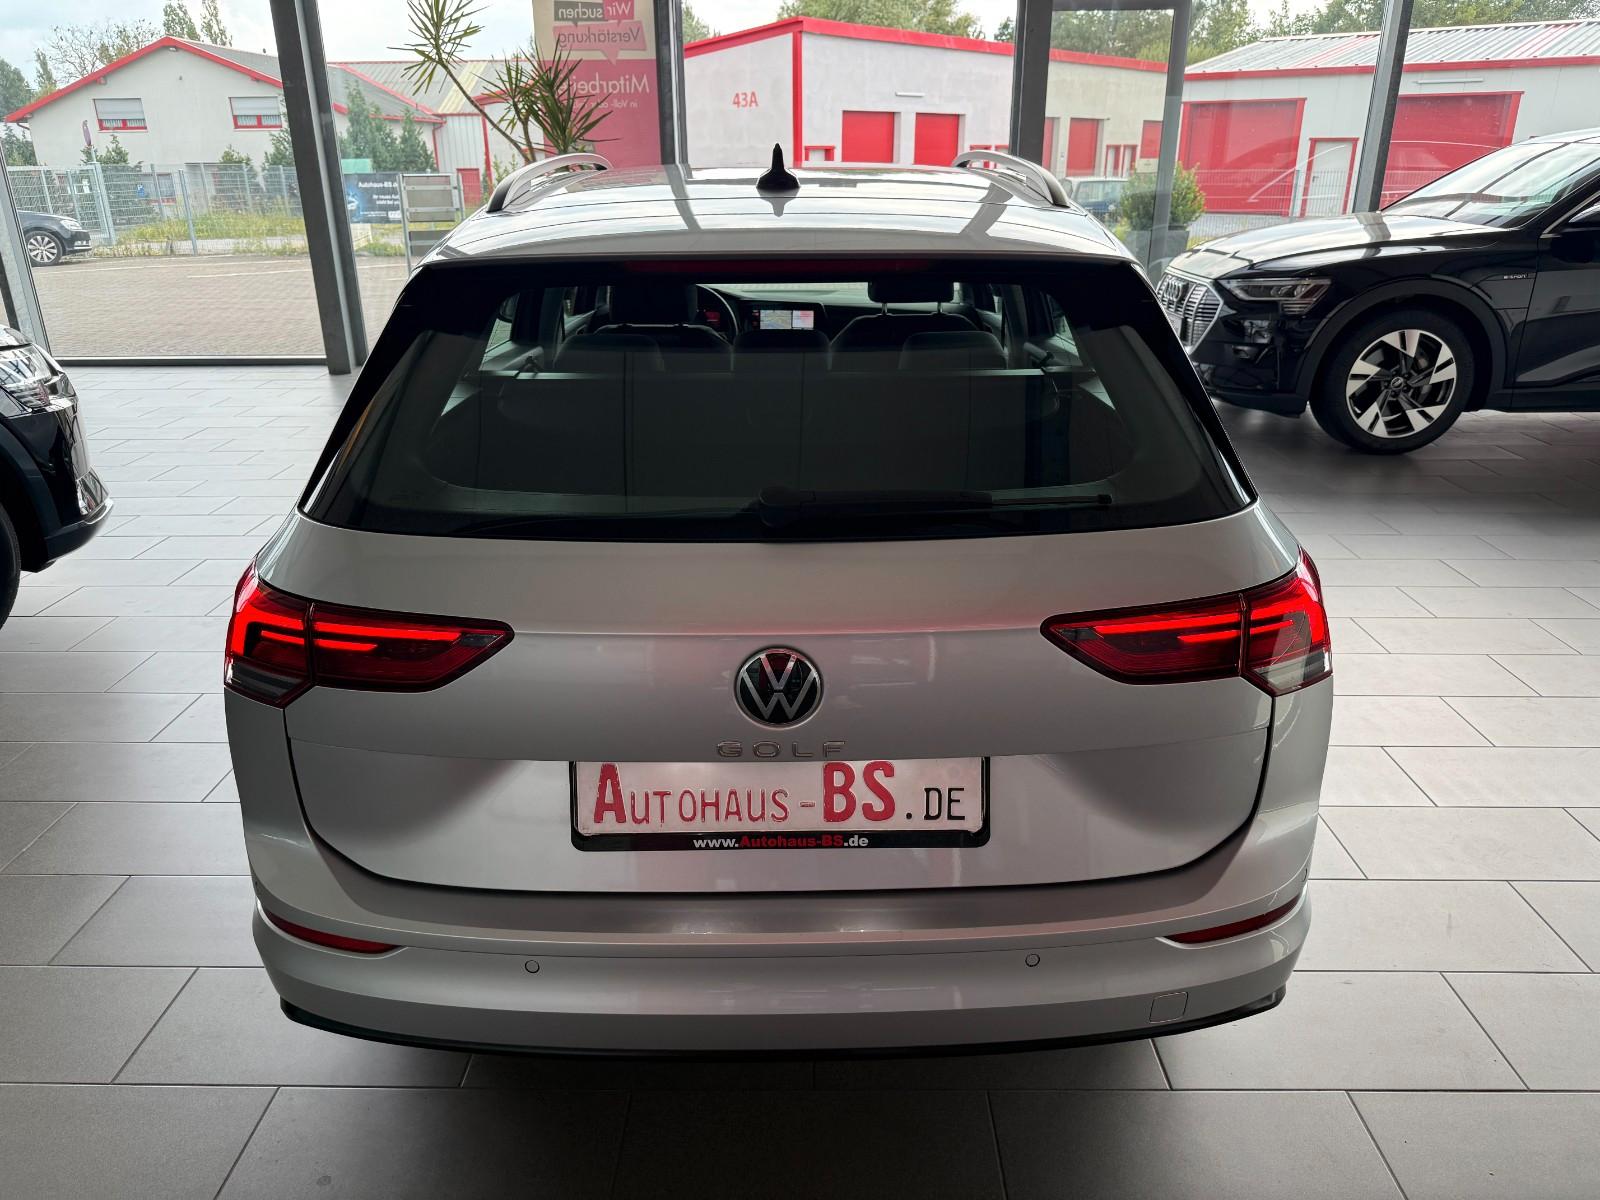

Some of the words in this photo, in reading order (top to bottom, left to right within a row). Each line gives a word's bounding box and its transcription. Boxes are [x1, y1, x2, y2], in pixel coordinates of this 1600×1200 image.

[732, 91, 759, 108] 43A
[716, 740, 846, 758] GOLF
[693, 834, 869, 848] www.Autohaus-BS.de
